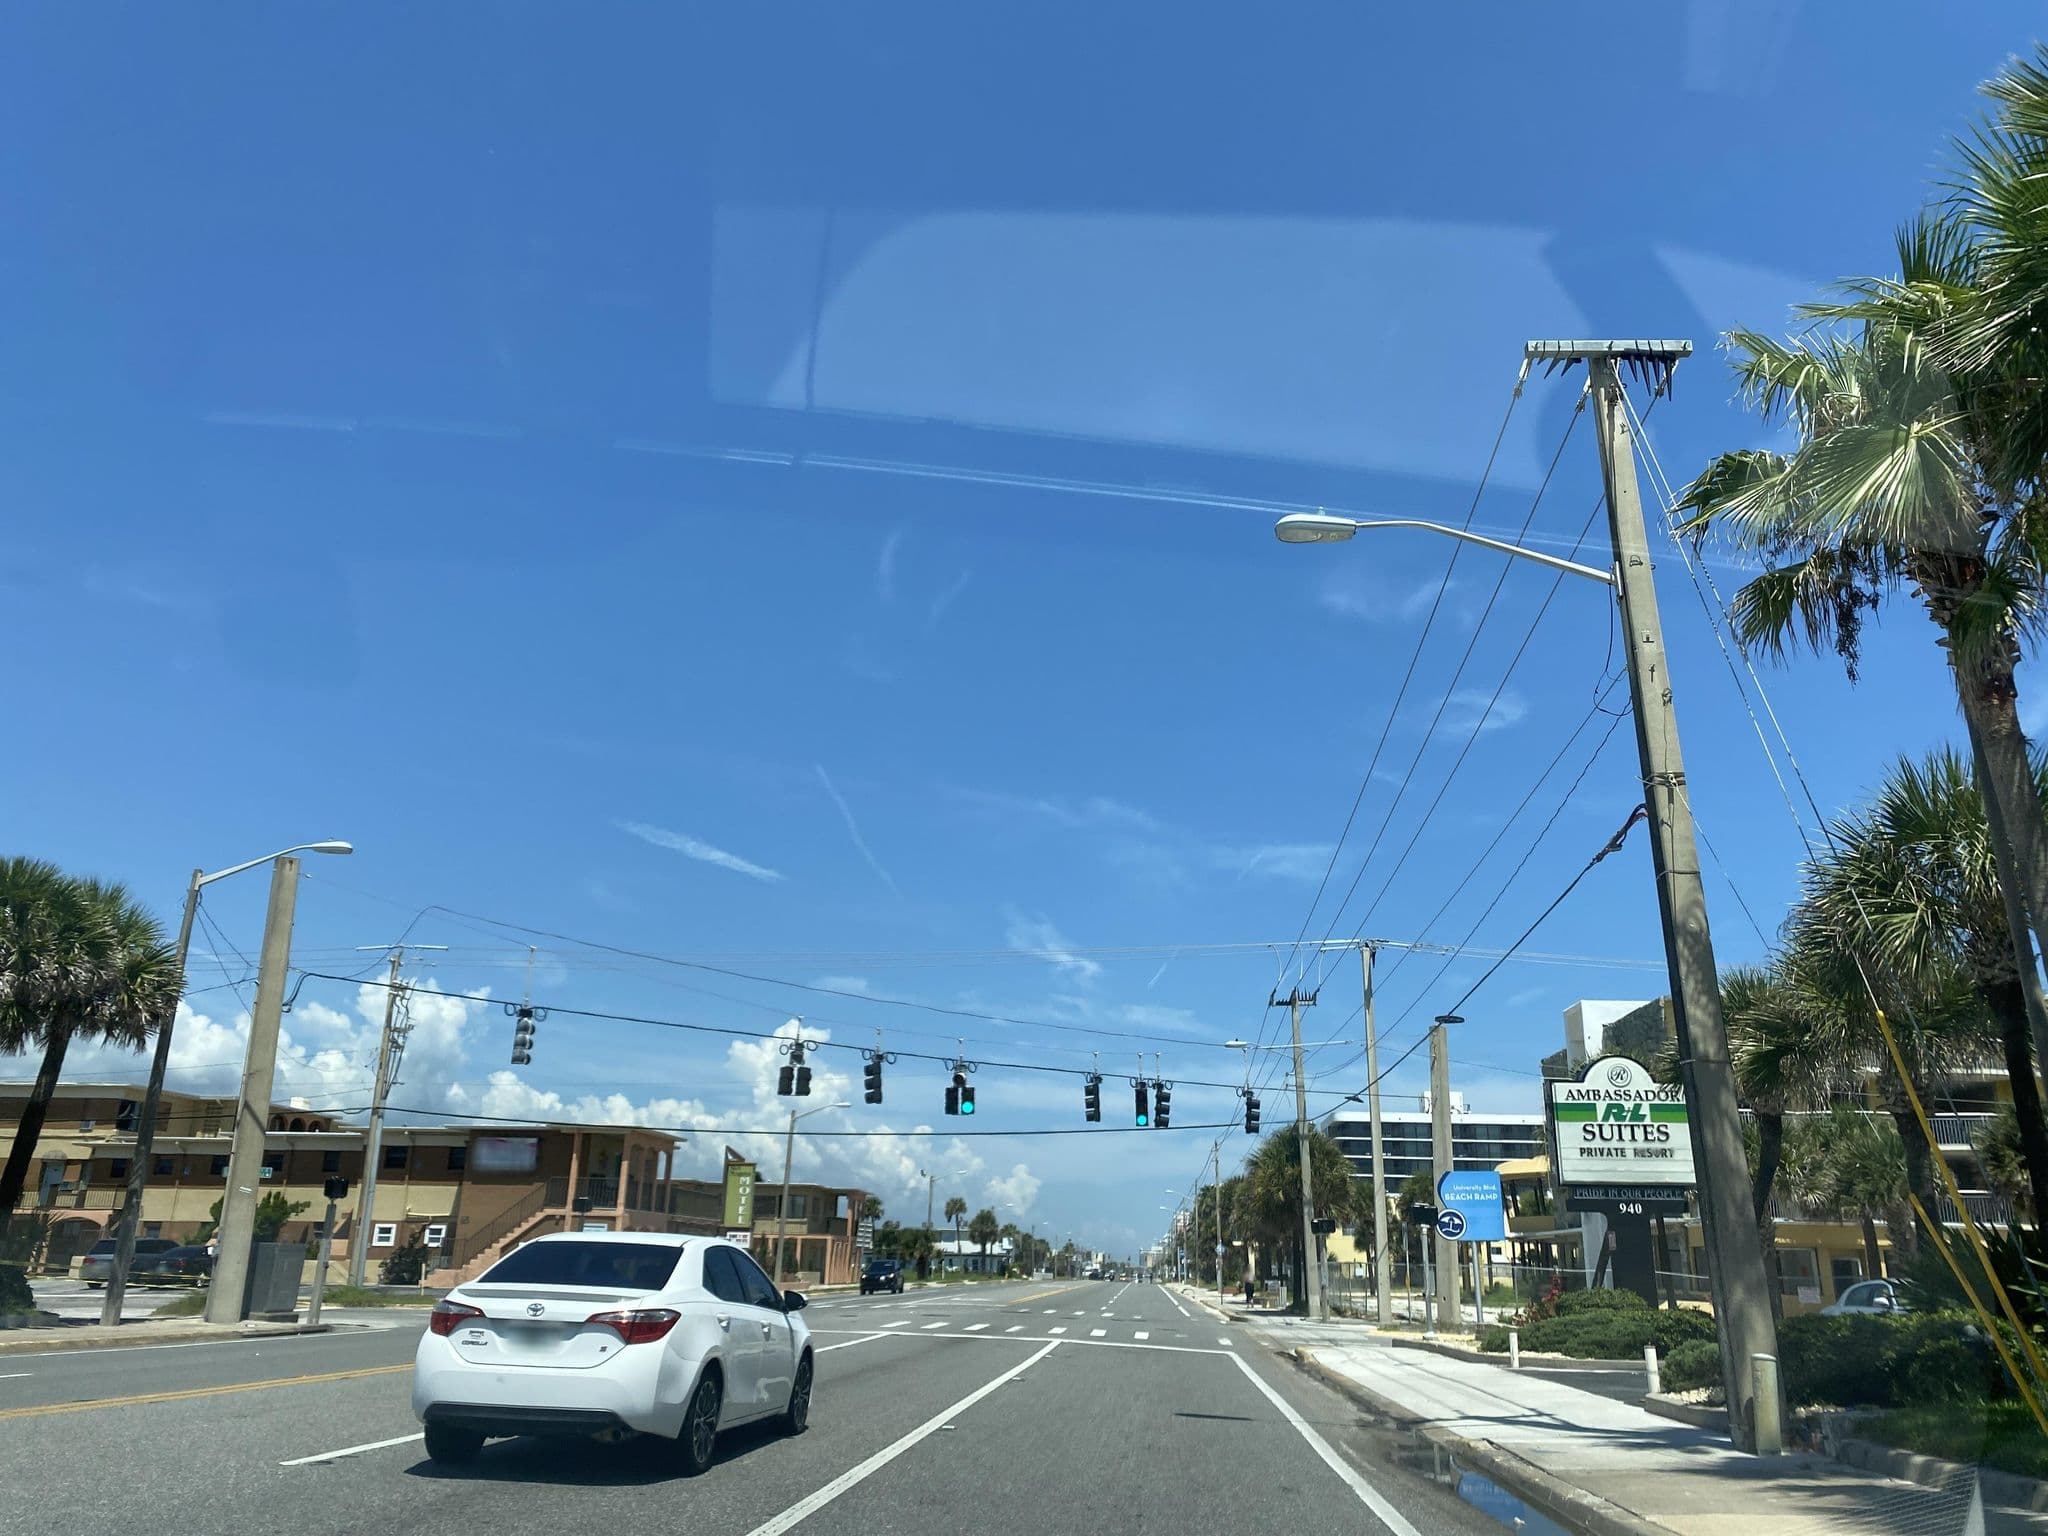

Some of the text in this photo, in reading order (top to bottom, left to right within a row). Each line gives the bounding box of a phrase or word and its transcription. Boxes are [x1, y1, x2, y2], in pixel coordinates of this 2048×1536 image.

[1565, 1088, 1681, 1103] AMBASSADOR
[1583, 1123, 1670, 1142] SUITES
[1579, 1147, 1674, 1159] PRIVATE RESORT
[1453, 1184, 1482, 1192] University
[1576, 1188, 1682, 1199] PRIDE IN OUR PEOPLE
[738, 1177, 750, 1224] MOTEL
[1619, 1202, 1643, 1215] 940
